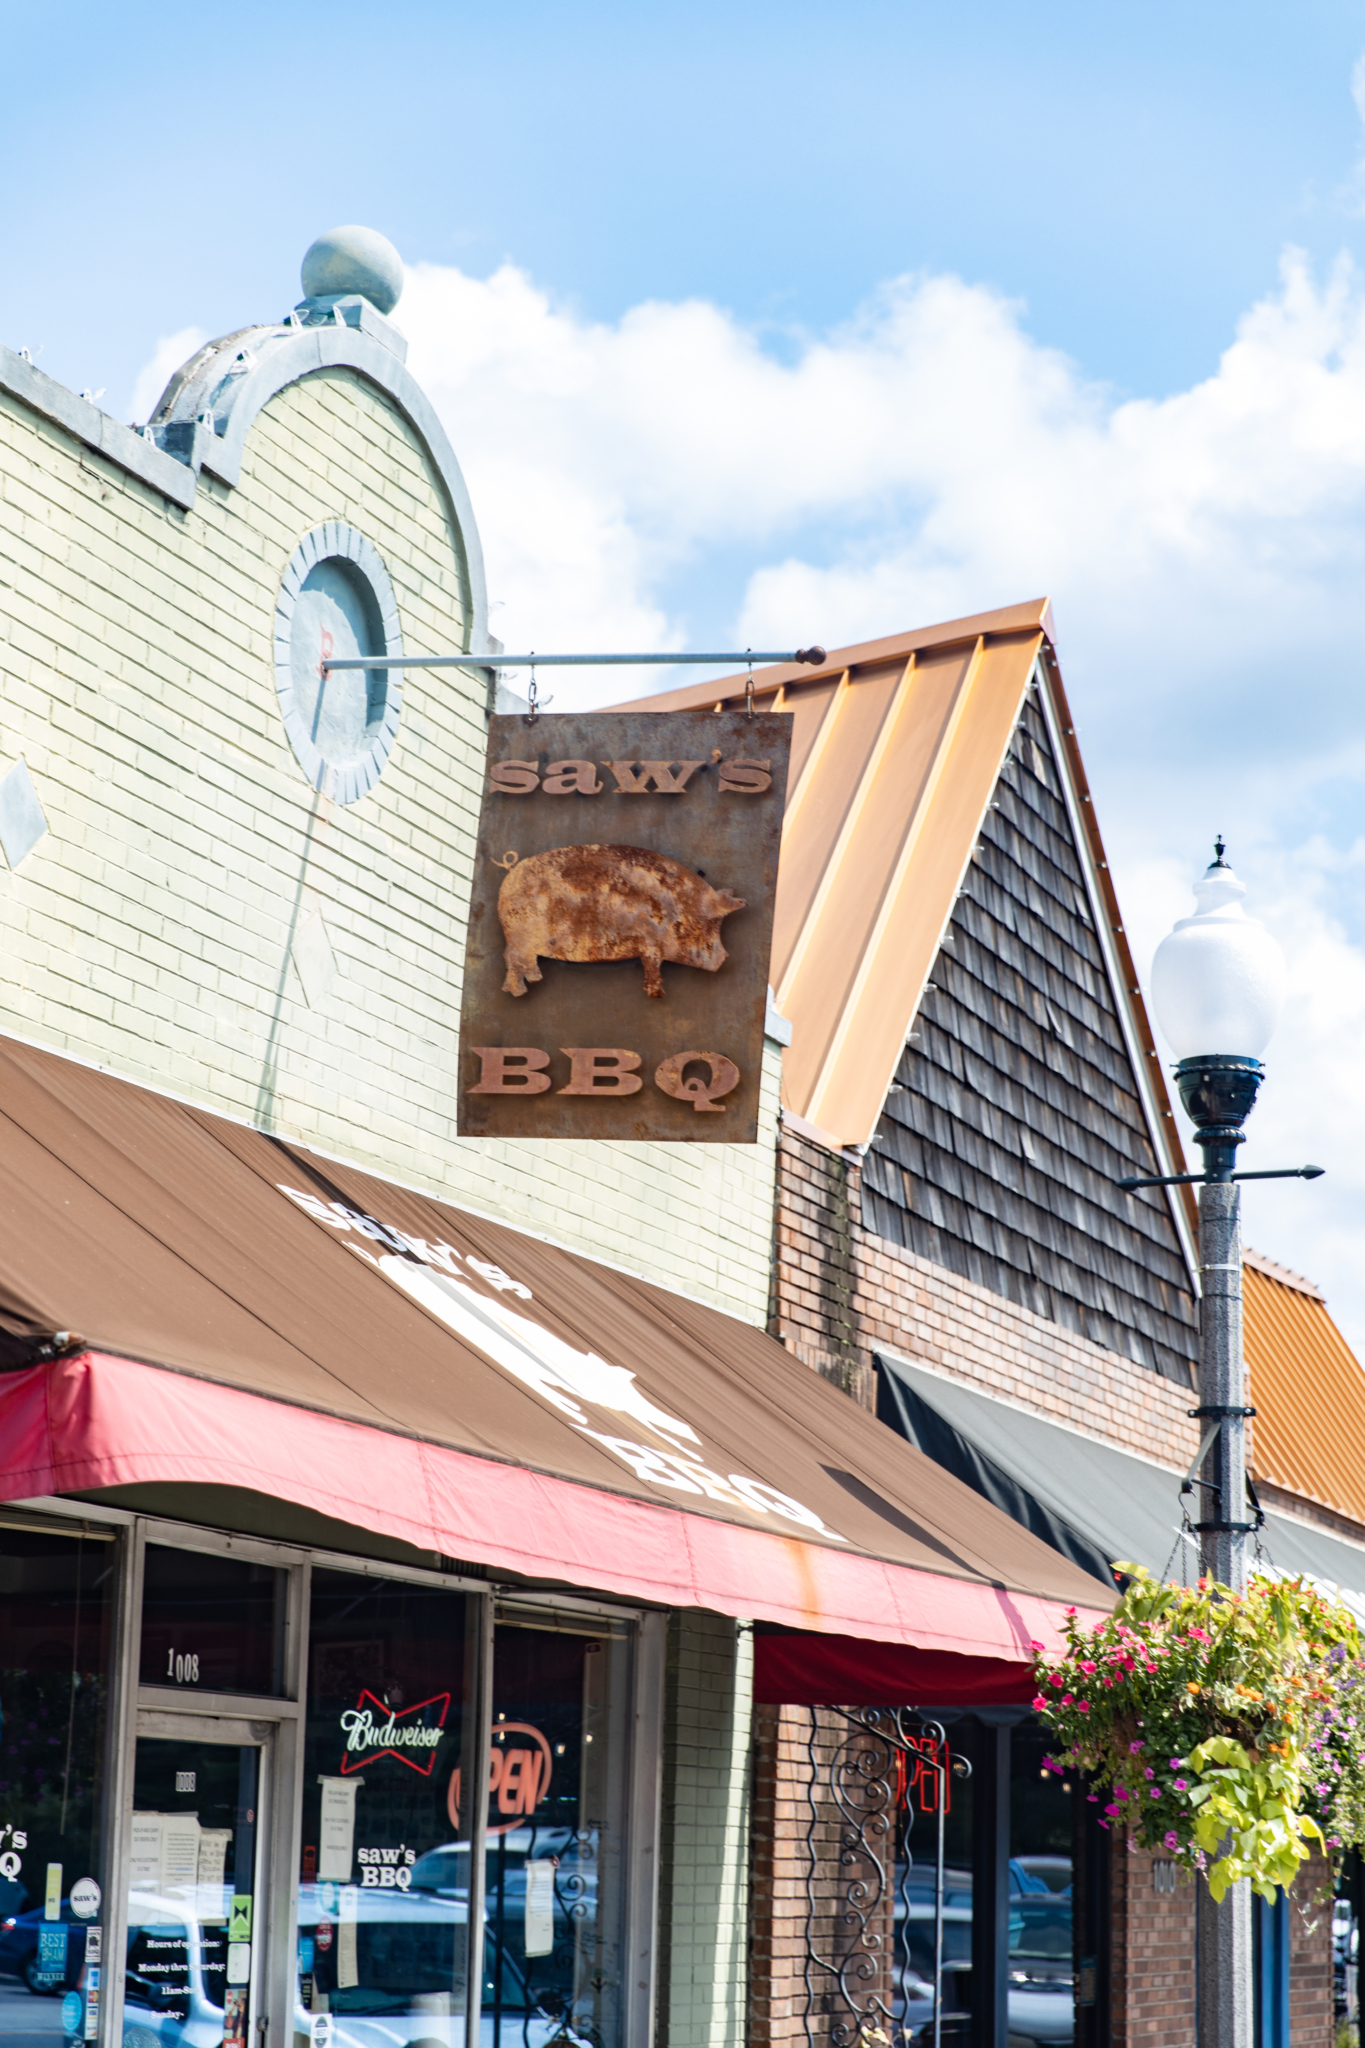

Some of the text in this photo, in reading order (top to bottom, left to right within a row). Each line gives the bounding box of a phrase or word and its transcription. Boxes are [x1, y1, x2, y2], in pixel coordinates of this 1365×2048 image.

[489, 748, 772, 795] saw's
[466, 1046, 741, 1112] BBQ
[568, 1422, 849, 1543] BBQ
[167, 1647, 199, 1683] 1008
[340, 1710, 444, 1751] Budweiser
[175, 1771, 196, 1792] 1008
[456, 1746, 543, 1815] PEN
[357, 1843, 416, 1865] saw's
[360, 1866, 412, 1892] BBQ
[1154, 1860, 1176, 1893] 1010
[40, 1932, 67, 1948] BEST
[146, 1939, 220, 1950] Hours of option:
[138, 1961, 226, 1973] Monday thru Surday:
